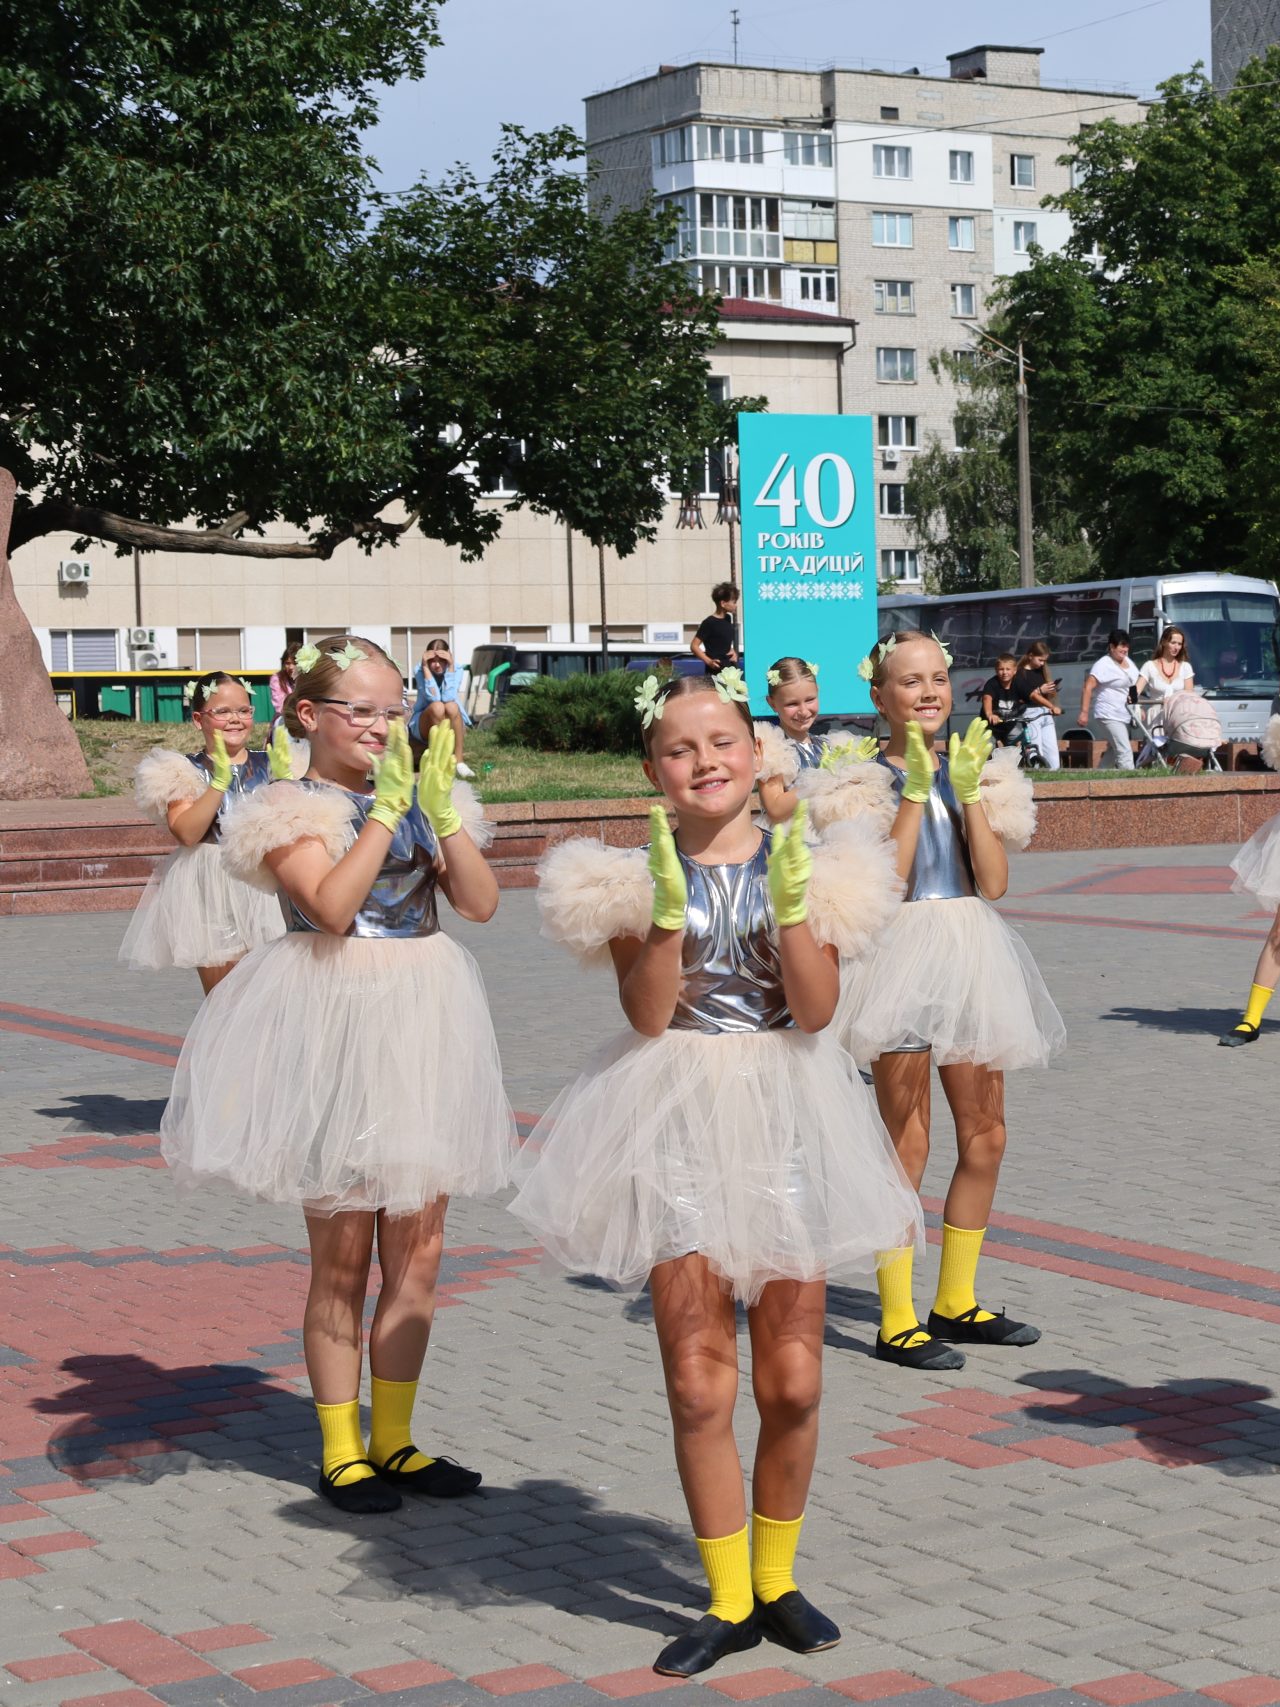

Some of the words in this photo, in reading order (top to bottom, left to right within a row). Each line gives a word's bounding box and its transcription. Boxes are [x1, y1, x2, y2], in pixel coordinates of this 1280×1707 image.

[753, 452, 856, 528] 40
[757, 532, 825, 549] РОКІВ
[757, 551, 864, 576] ТРАДИЦІЙ
